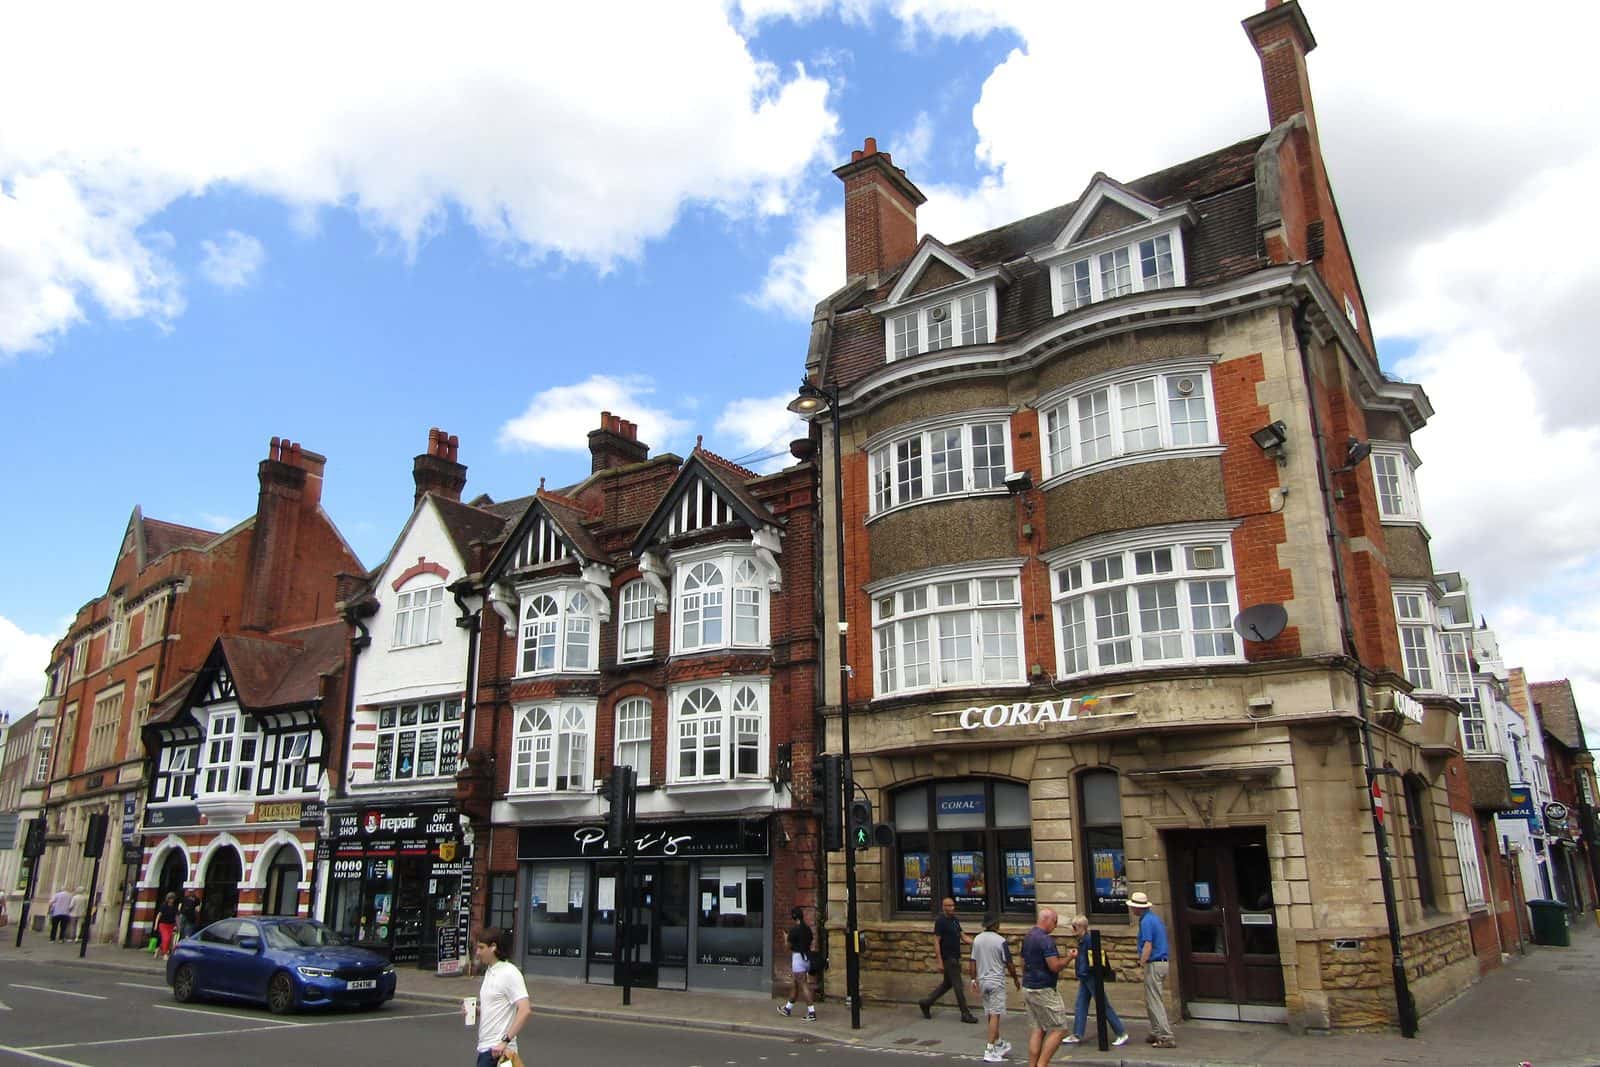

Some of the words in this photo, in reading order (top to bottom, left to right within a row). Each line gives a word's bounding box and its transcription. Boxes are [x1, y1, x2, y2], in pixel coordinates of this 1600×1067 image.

[959, 697, 1078, 730] CORAL
[941, 800, 975, 810] CORAL
[340, 817, 358, 826] VAPE
[379, 812, 419, 833] irepair
[433, 813, 446, 822] OFF
[339, 827, 359, 836] SHOP
[426, 823, 454, 833] LICENCE
